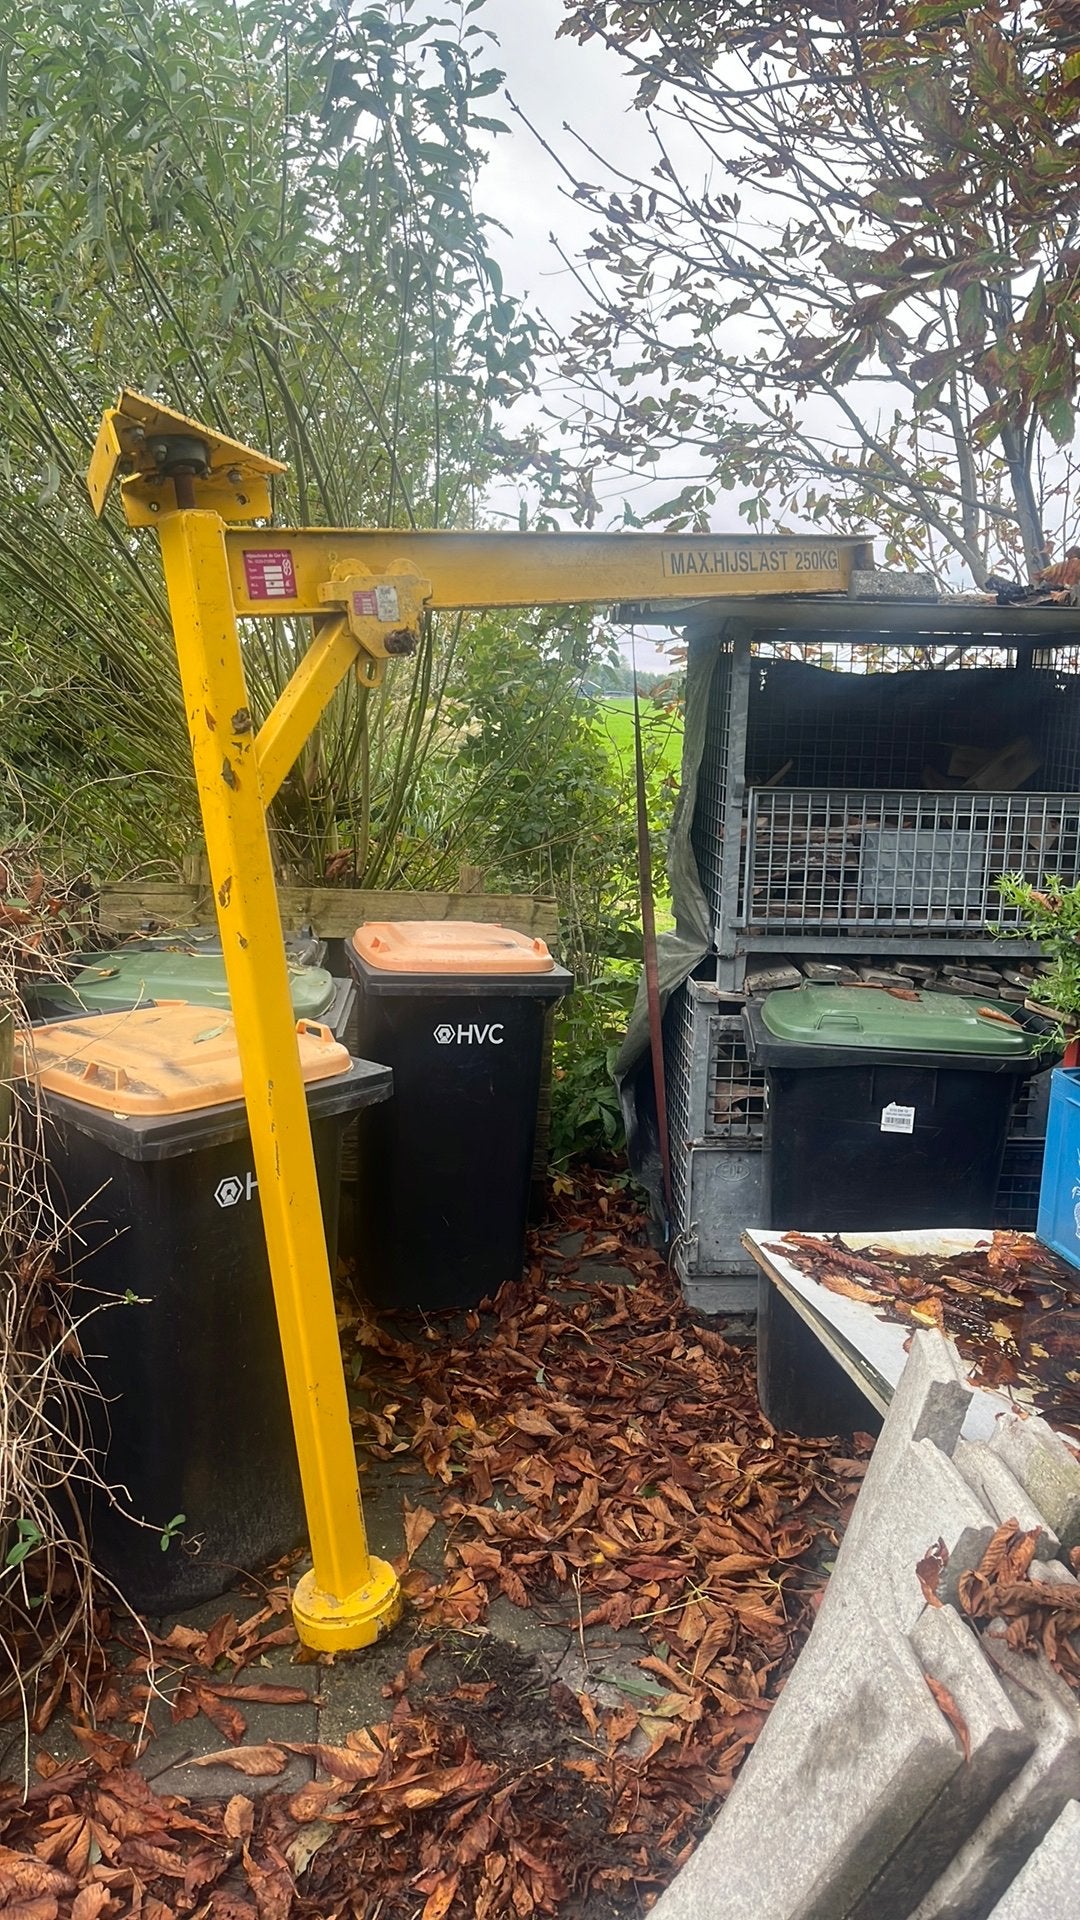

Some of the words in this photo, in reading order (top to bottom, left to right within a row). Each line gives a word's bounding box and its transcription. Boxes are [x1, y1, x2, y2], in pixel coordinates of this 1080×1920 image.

[670, 551, 788, 574] MAX.HIJSLAST
[795, 550, 838, 571] 250KG
[457, 1023, 504, 1045] HVC
